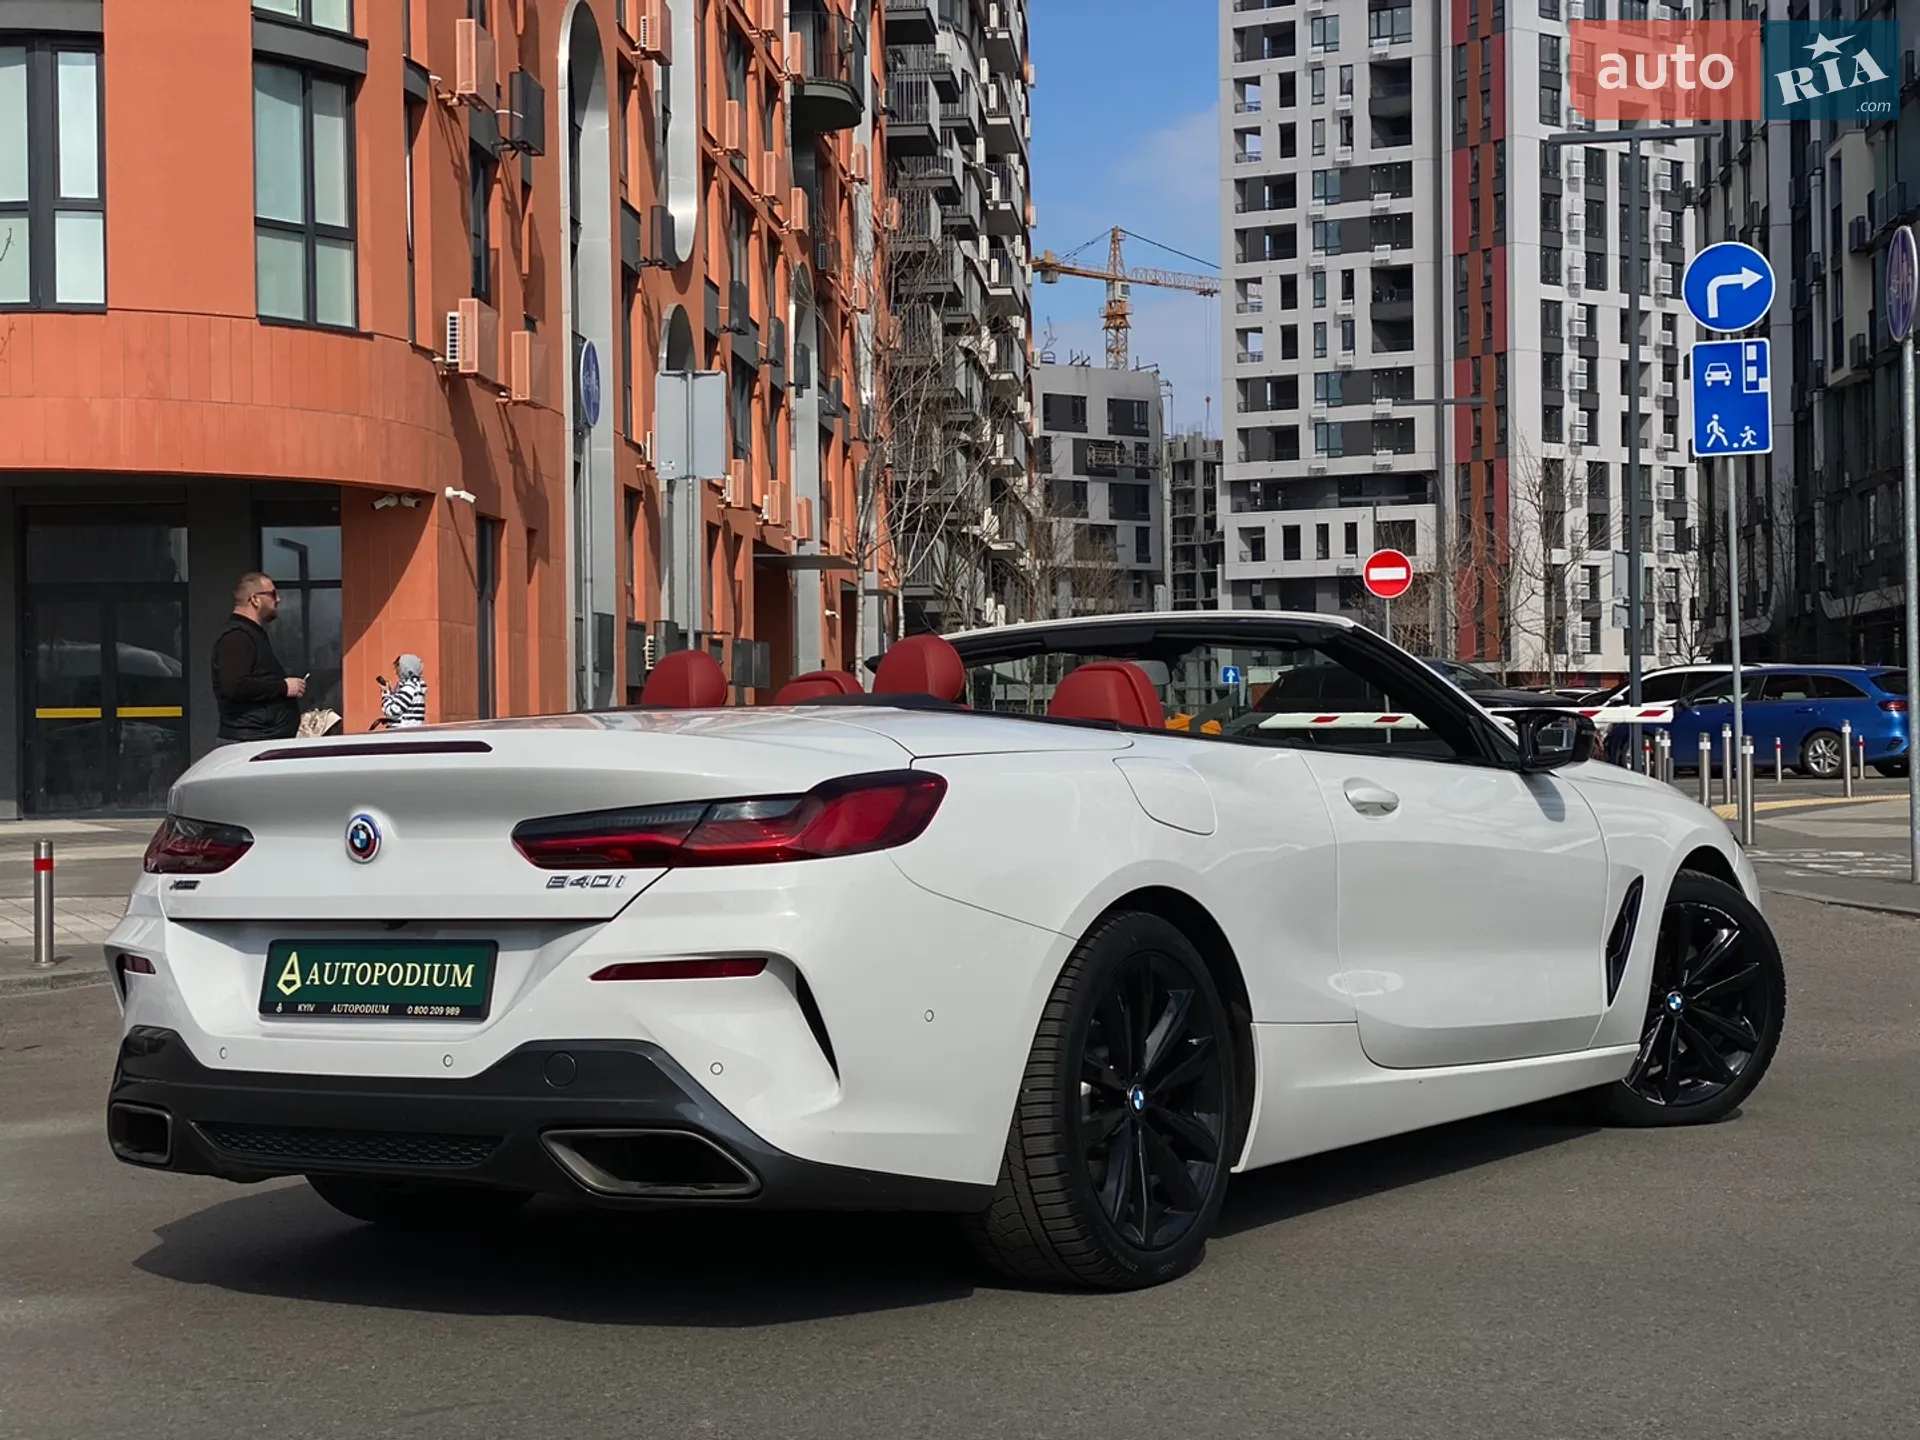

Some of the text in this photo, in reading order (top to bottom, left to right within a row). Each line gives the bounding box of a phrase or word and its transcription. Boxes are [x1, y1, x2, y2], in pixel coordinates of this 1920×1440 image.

[305, 962, 475, 988] AUTOPODIUM
[297, 1003, 316, 1012] KYIV
[330, 1003, 390, 1014] AUTOPODIUM
[406, 1005, 413, 1015] 0
[413, 1005, 428, 1015] 800
[429, 1006, 444, 1016] 209
